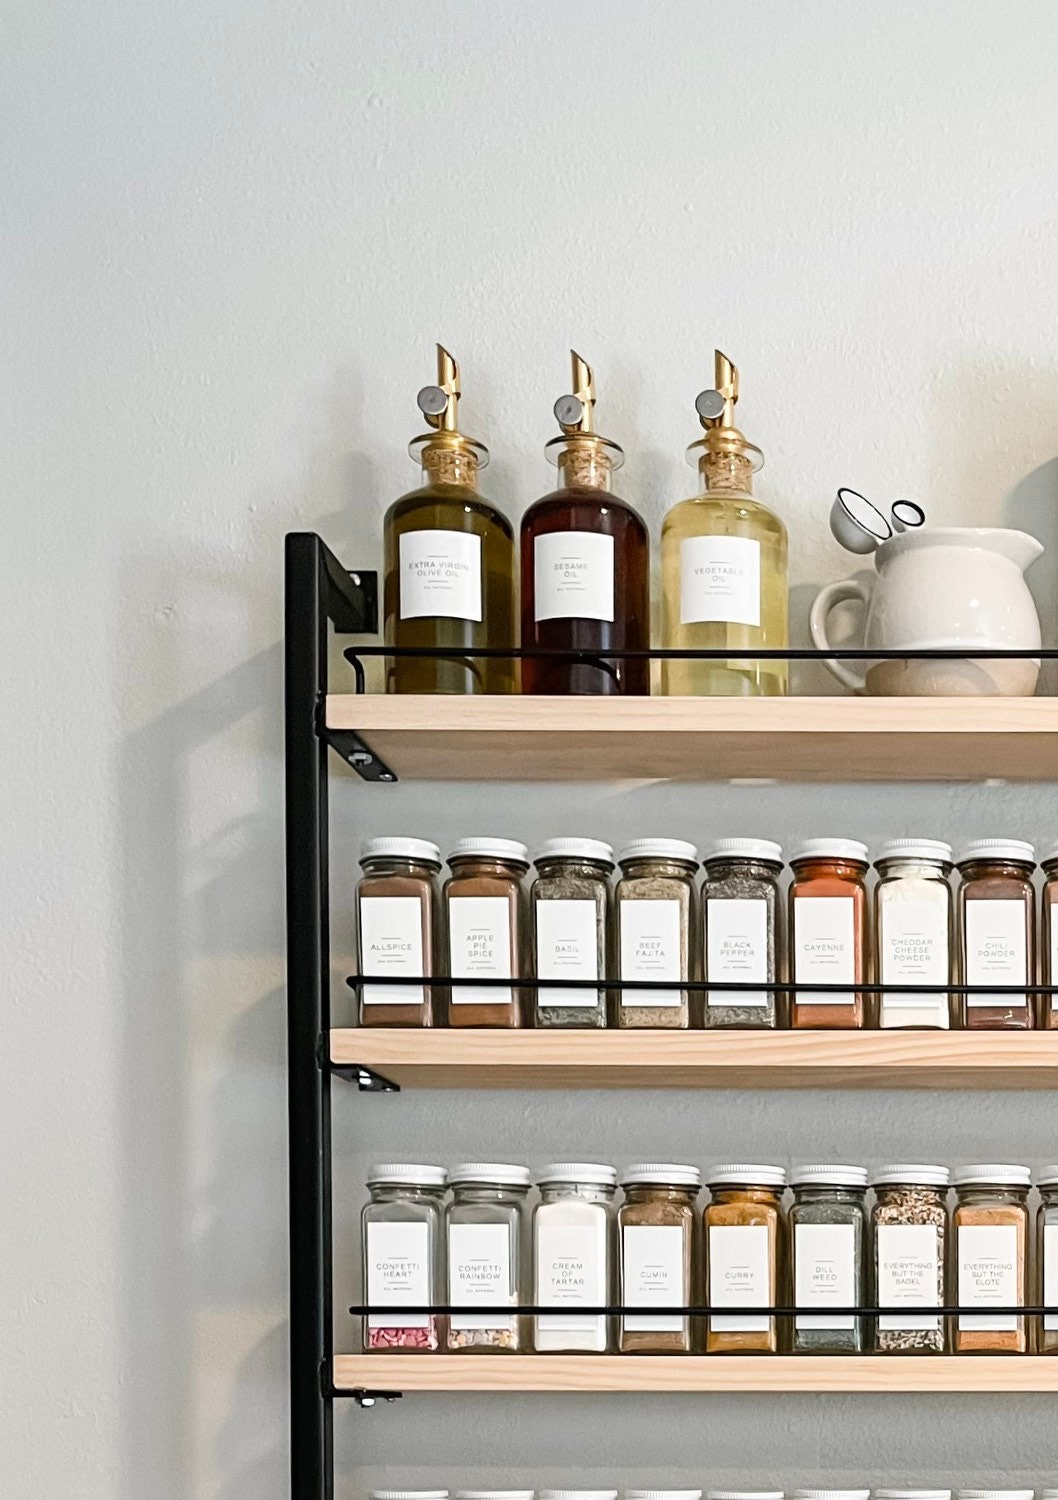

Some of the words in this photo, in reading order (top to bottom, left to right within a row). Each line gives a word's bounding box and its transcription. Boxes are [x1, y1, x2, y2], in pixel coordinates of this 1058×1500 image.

[409, 561, 435, 571] EXTRA
[553, 562, 589, 571] SESAME
[416, 569, 442, 578] OLIVE
[445, 570, 459, 578] OIL
[564, 571, 578, 579] OIL
[712, 575, 726, 583] OIL
[466, 934, 494, 942] APPLE
[473, 942, 488, 950] PIE
[637, 941, 661, 950] BEEF
[723, 941, 751, 949] BLACK
[891, 938, 933, 947] CHEDDAR
[985, 942, 1008, 950] CHILI
[370, 943, 413, 951] ALLSPICE
[554, 945, 580, 953] BASIL
[804, 944, 845, 952] CAYENNE
[895, 946, 930, 954] CHEESE
[468, 950, 494, 958] SPICE
[634, 949, 665, 957] FAJITA
[720, 949, 754, 957] PEPPER
[977, 950, 1015, 958] POWDER
[893, 954, 931, 962] POWDER
[376, 1263, 420, 1271] CONFETTI
[458, 1264, 502, 1273] CONFETTI
[552, 1262, 583, 1270] CREAM
[815, 1266, 833, 1274] DILL
[884, 1262, 932, 1270] EVERYTHING
[963, 1263, 1012, 1271] EVERYTHING
[383, 1270, 413, 1279] HEART
[460, 1272, 501, 1280] RAINBOW
[640, 1271, 668, 1279] CUMIN
[725, 1272, 754, 1280] CURRY
[812, 1273, 838, 1282] WEED
[891, 1269, 907, 1278] BUT
[909, 1269, 924, 1278] THE
[972, 1270, 987, 1279] BUT
[989, 1270, 1004, 1279] THE
[551, 1278, 585, 1286] TARTAR
